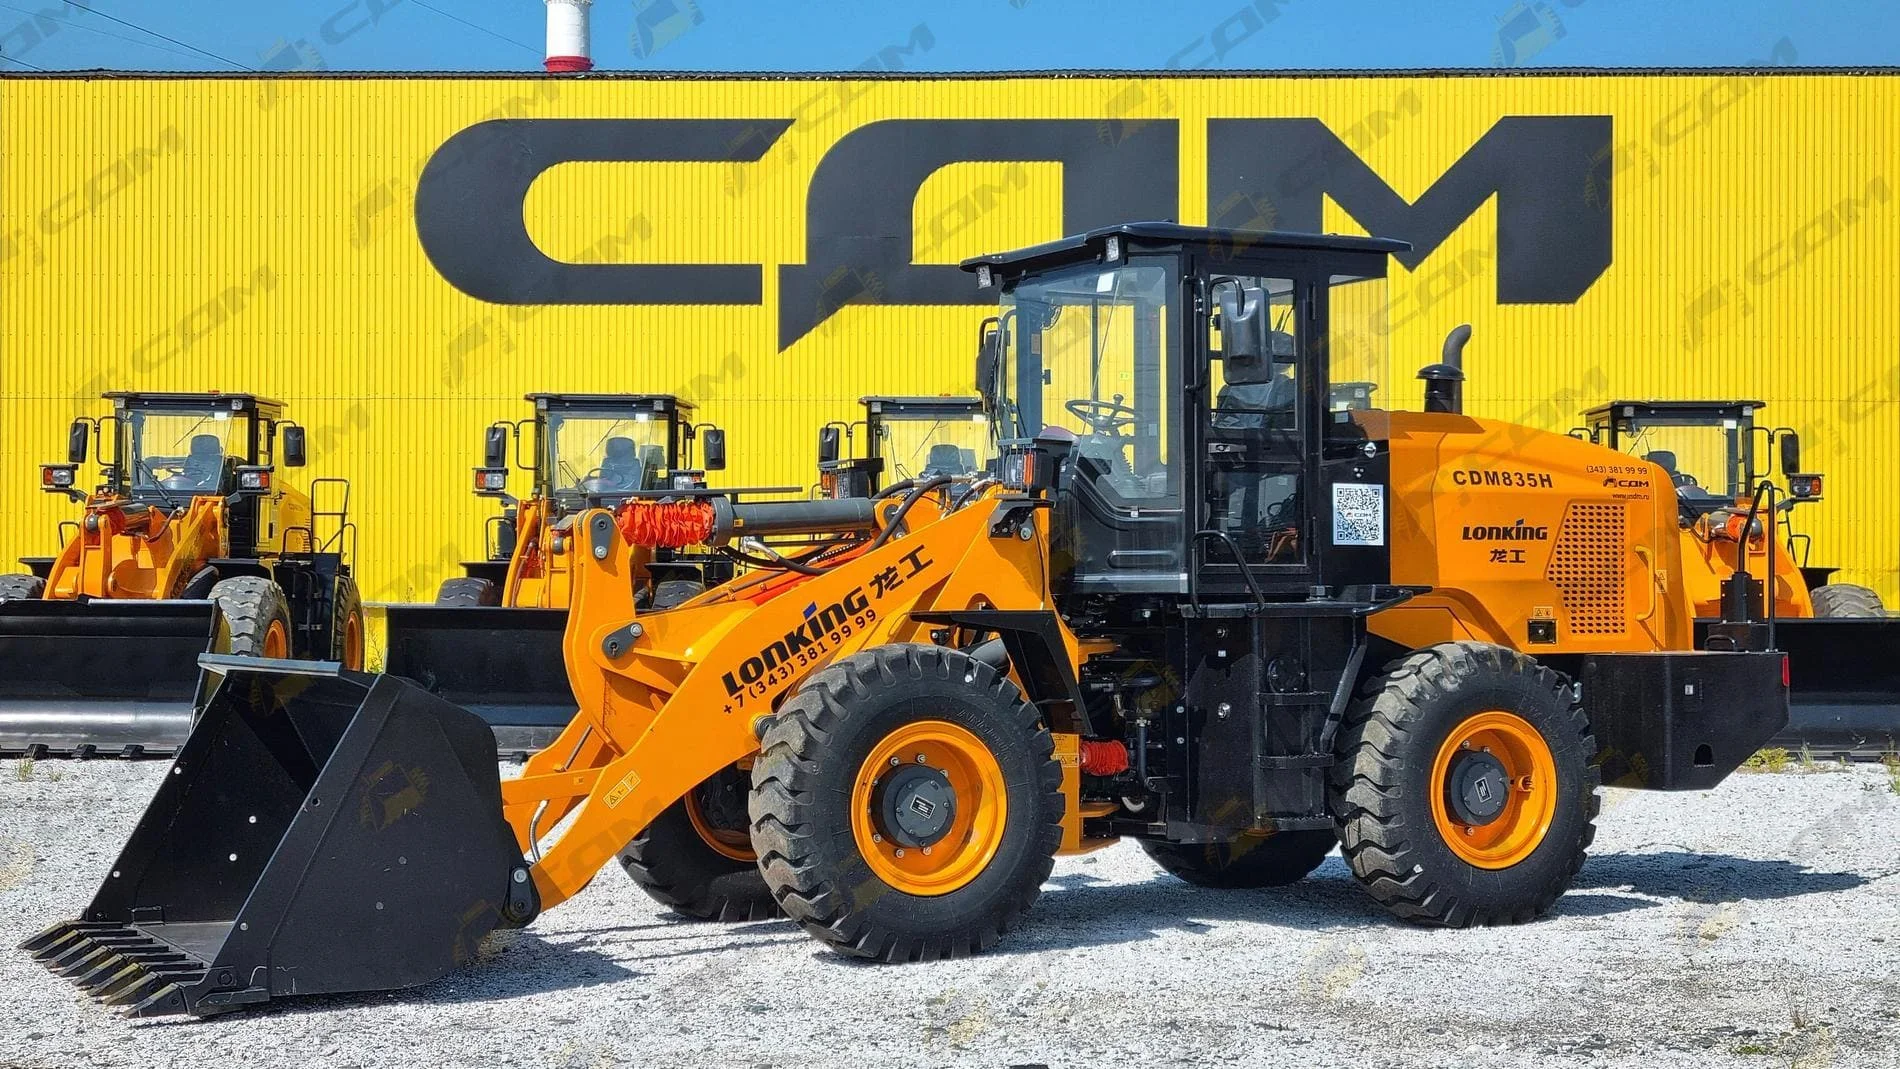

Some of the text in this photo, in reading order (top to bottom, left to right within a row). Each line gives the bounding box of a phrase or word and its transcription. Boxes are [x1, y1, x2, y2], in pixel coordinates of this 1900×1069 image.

[1453, 470, 1553, 489] CDM835H
[1586, 465, 1648, 475] (343) 381 99 99
[1489, 548, 1526, 563] 龙工
[869, 544, 933, 599] 龙工
[797, 643, 828, 668] 381
[830, 624, 852, 645] 99
[855, 608, 877, 629] 99
